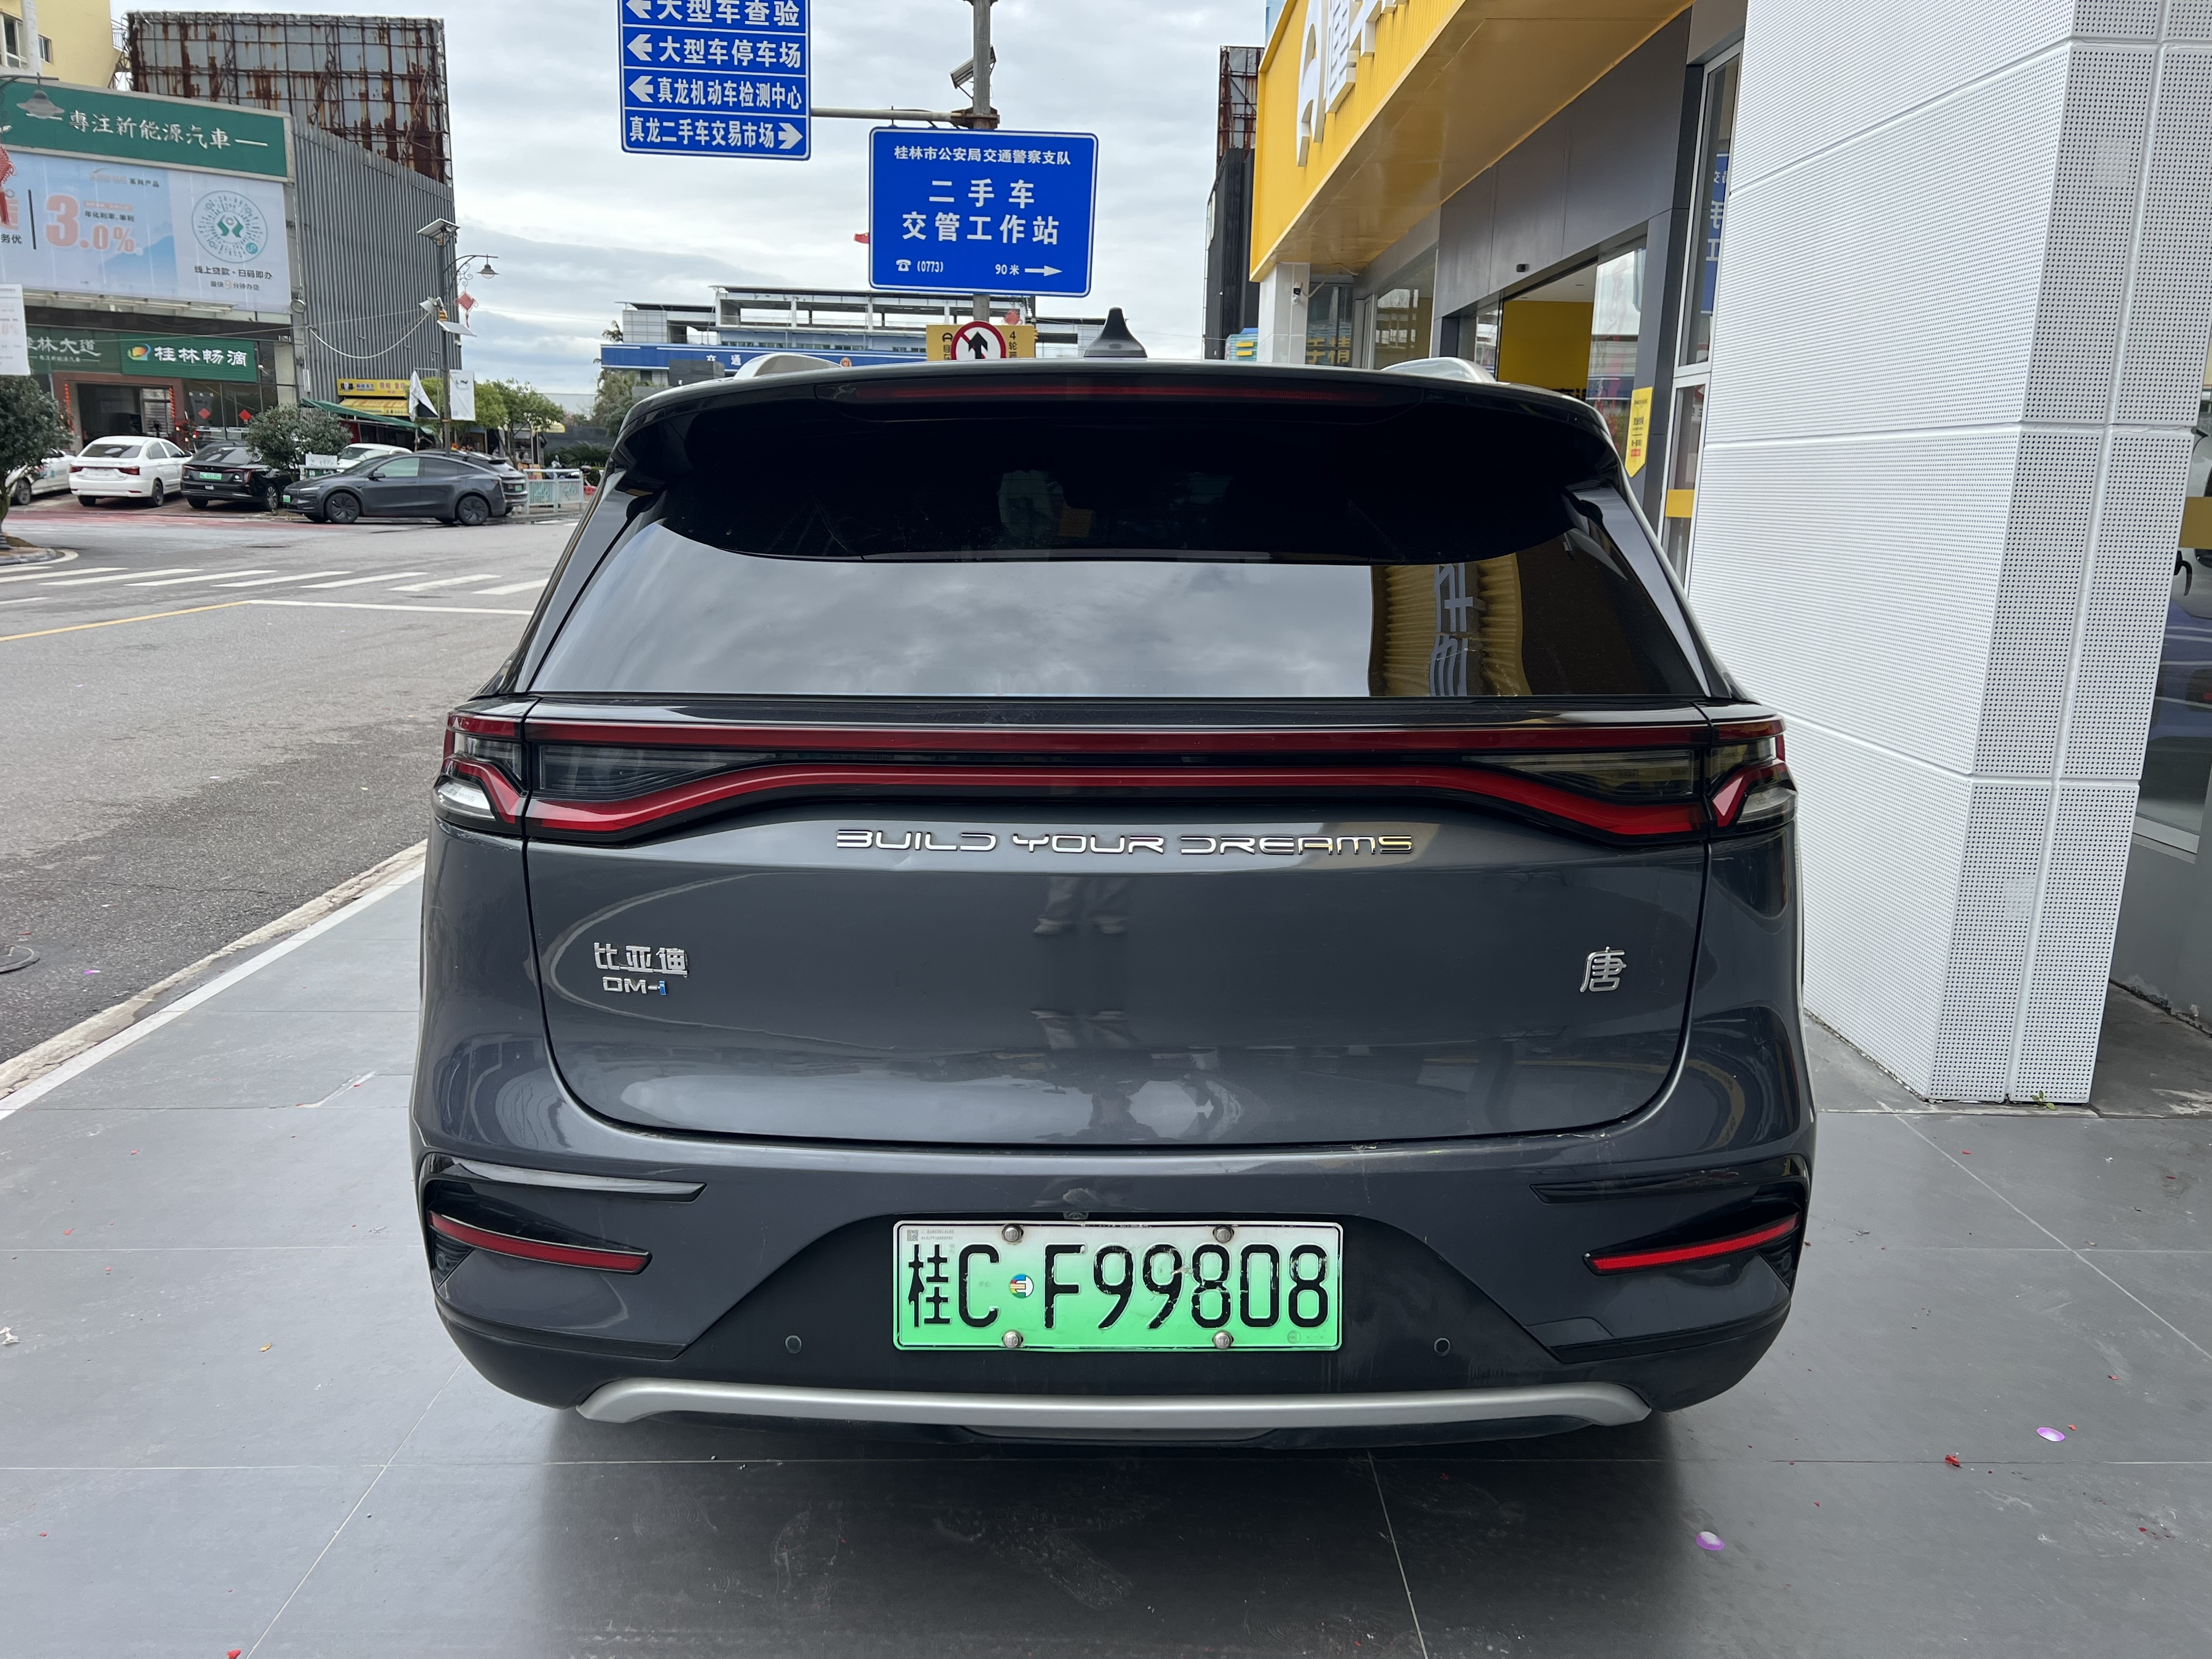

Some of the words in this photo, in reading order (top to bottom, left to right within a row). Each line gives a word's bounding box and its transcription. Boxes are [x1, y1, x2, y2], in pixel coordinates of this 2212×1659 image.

[657, 0, 799, 26] 大型车查验
[659, 36, 801, 68] 大型车停车场
[657, 77, 802, 110] 真龙机动车检测中心
[630, 116, 775, 148] 真龙二手车交易市场
[894, 145, 1071, 165] 桂林市公安局交通警察支队
[929, 178, 1035, 208] 二手车
[902, 211, 1059, 245] 交管工作站
[917, 261, 944, 273] (0773)
[154, 346, 247, 367] 桂林畅滴
[836, 830, 996, 851] BUILD
[1013, 833, 1164, 855] YOUR
[1181, 834, 1413, 855] DREAMS
[594, 943, 688, 977] 比亚迪
[1580, 946, 1627, 992] 唐
[602, 977, 666, 996] DM-i
